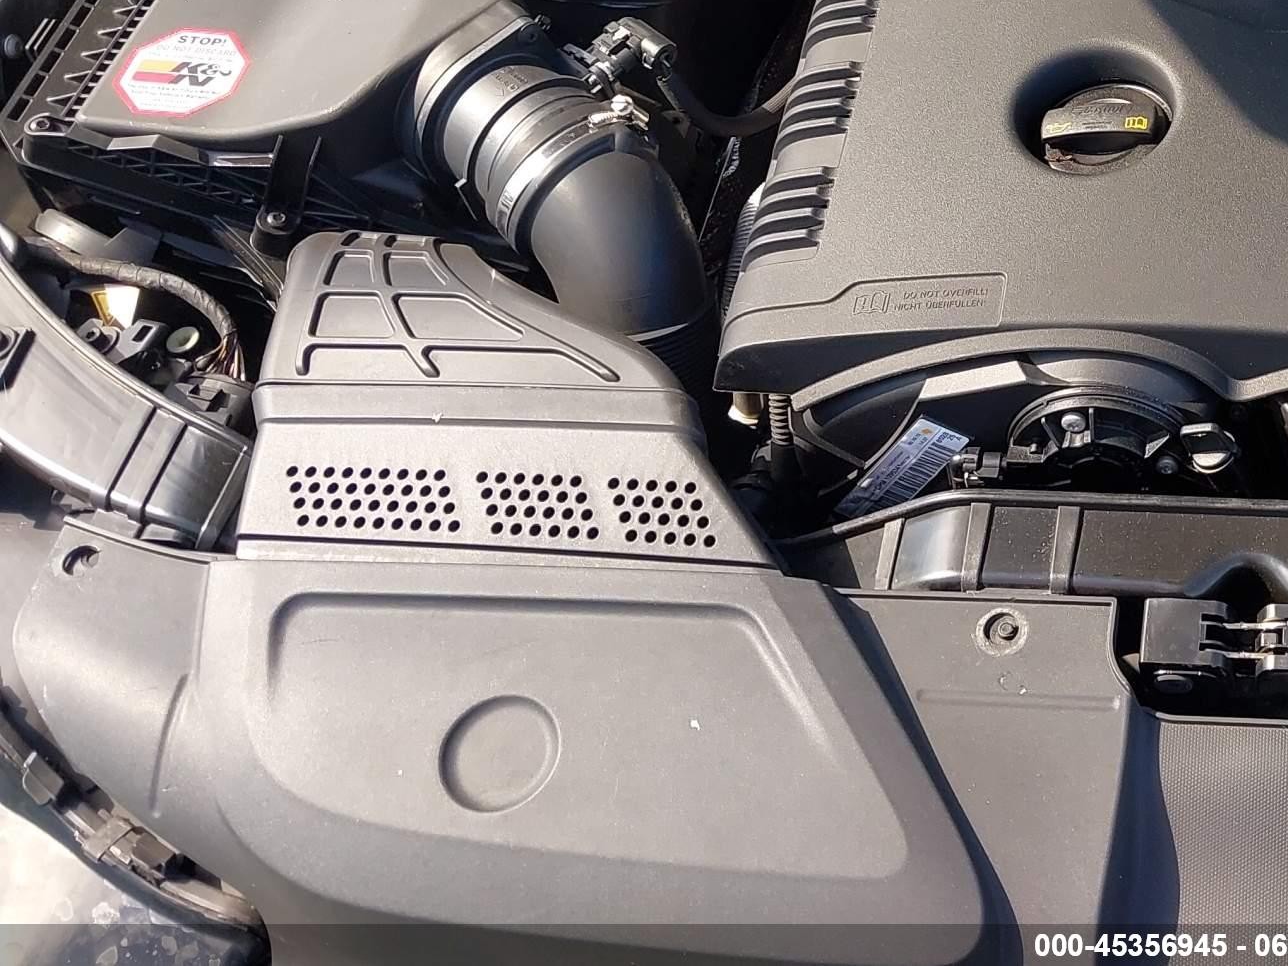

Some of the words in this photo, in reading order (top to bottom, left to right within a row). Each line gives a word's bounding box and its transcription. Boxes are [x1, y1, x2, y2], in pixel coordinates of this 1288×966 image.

[178, 36, 227, 46] STOP!
[904, 291, 917, 299] DO
[921, 290, 939, 298] NOT
[894, 303, 921, 311] NICHT
